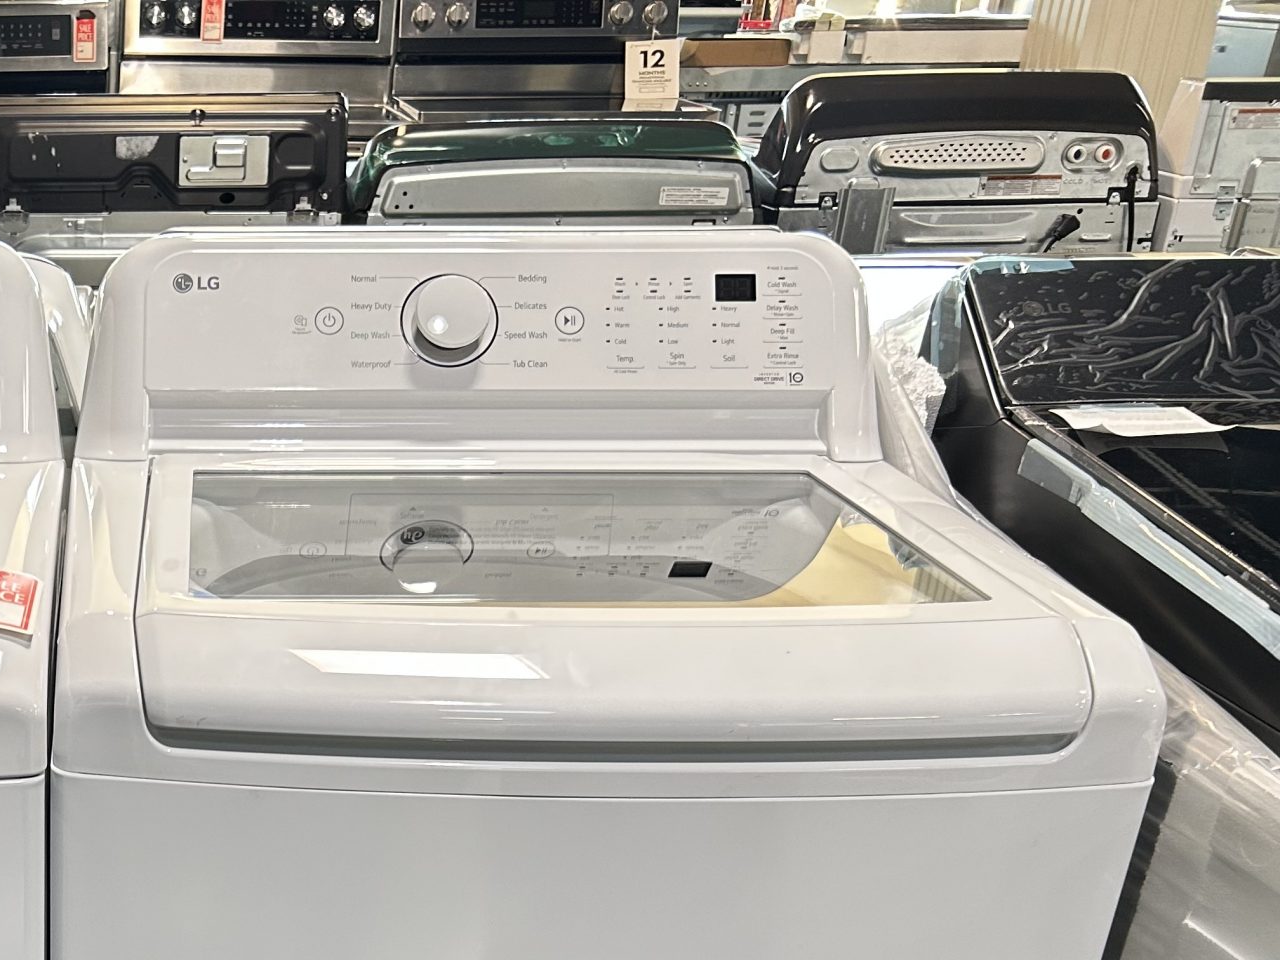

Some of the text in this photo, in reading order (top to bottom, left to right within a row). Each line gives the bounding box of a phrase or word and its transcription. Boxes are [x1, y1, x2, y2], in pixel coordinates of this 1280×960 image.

[639, 49, 665, 68] 12
[197, 276, 220, 290] LG
[351, 275, 377, 283] Normal
[518, 275, 547, 283] Bedding
[351, 302, 392, 311] Heavy Duty
[1047, 302, 1072, 314] LG
[351, 331, 390, 340] Deep Wash
[504, 331, 548, 340] Speed Wash
[770, 328, 784, 336] Deep
[669, 352, 684, 360] Spin
[351, 360, 391, 369] Waterproof
[513, 360, 548, 368] Tub Clean
[789, 372, 803, 383] 10
